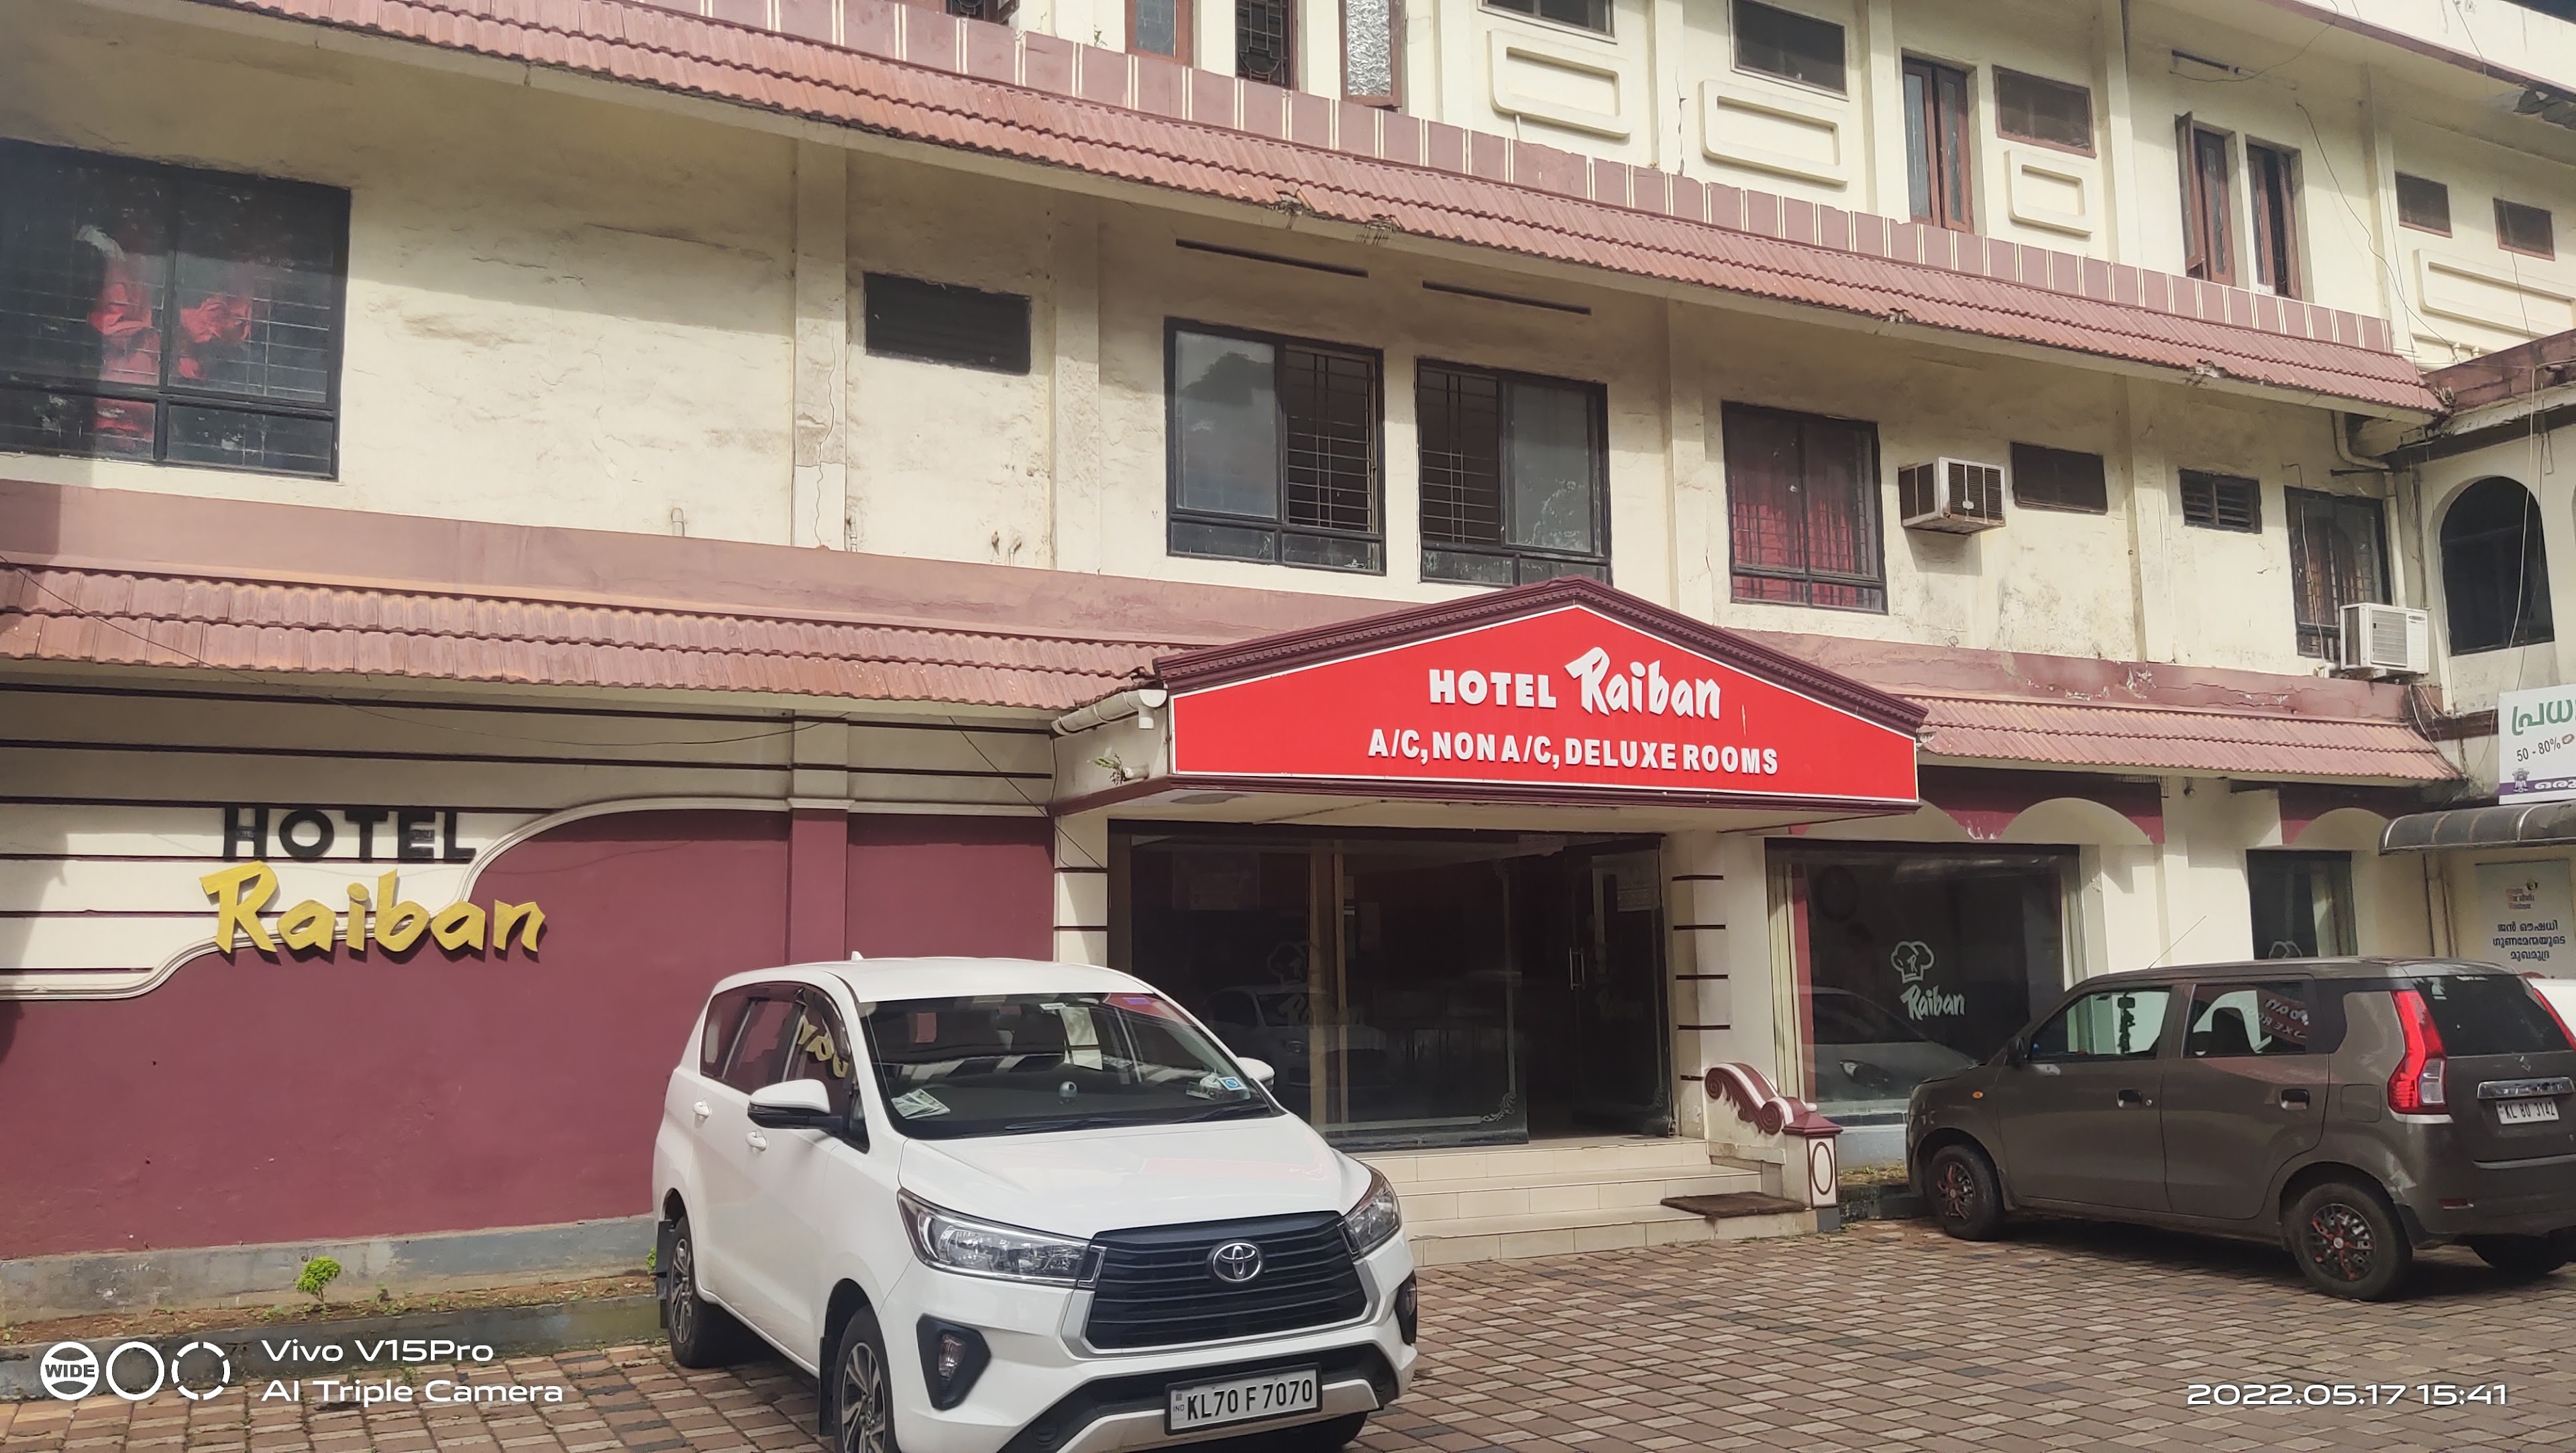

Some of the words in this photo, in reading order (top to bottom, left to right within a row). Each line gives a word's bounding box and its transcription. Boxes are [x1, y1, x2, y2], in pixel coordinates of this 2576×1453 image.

[1429, 669, 1557, 708] HOTEL
[1564, 646, 1721, 720] Raiban
[1682, 743, 1778, 775] ROOMS
[2538, 737, 2561, 755] 80%
[223, 805, 476, 863] HOTEL
[199, 860, 546, 954] Raiban
[1899, 984, 1965, 1020] Raiban
[1187, 1389, 1238, 1420] KL70
[1246, 1386, 1257, 1411] F
[1263, 1379, 1312, 1409] 7070
